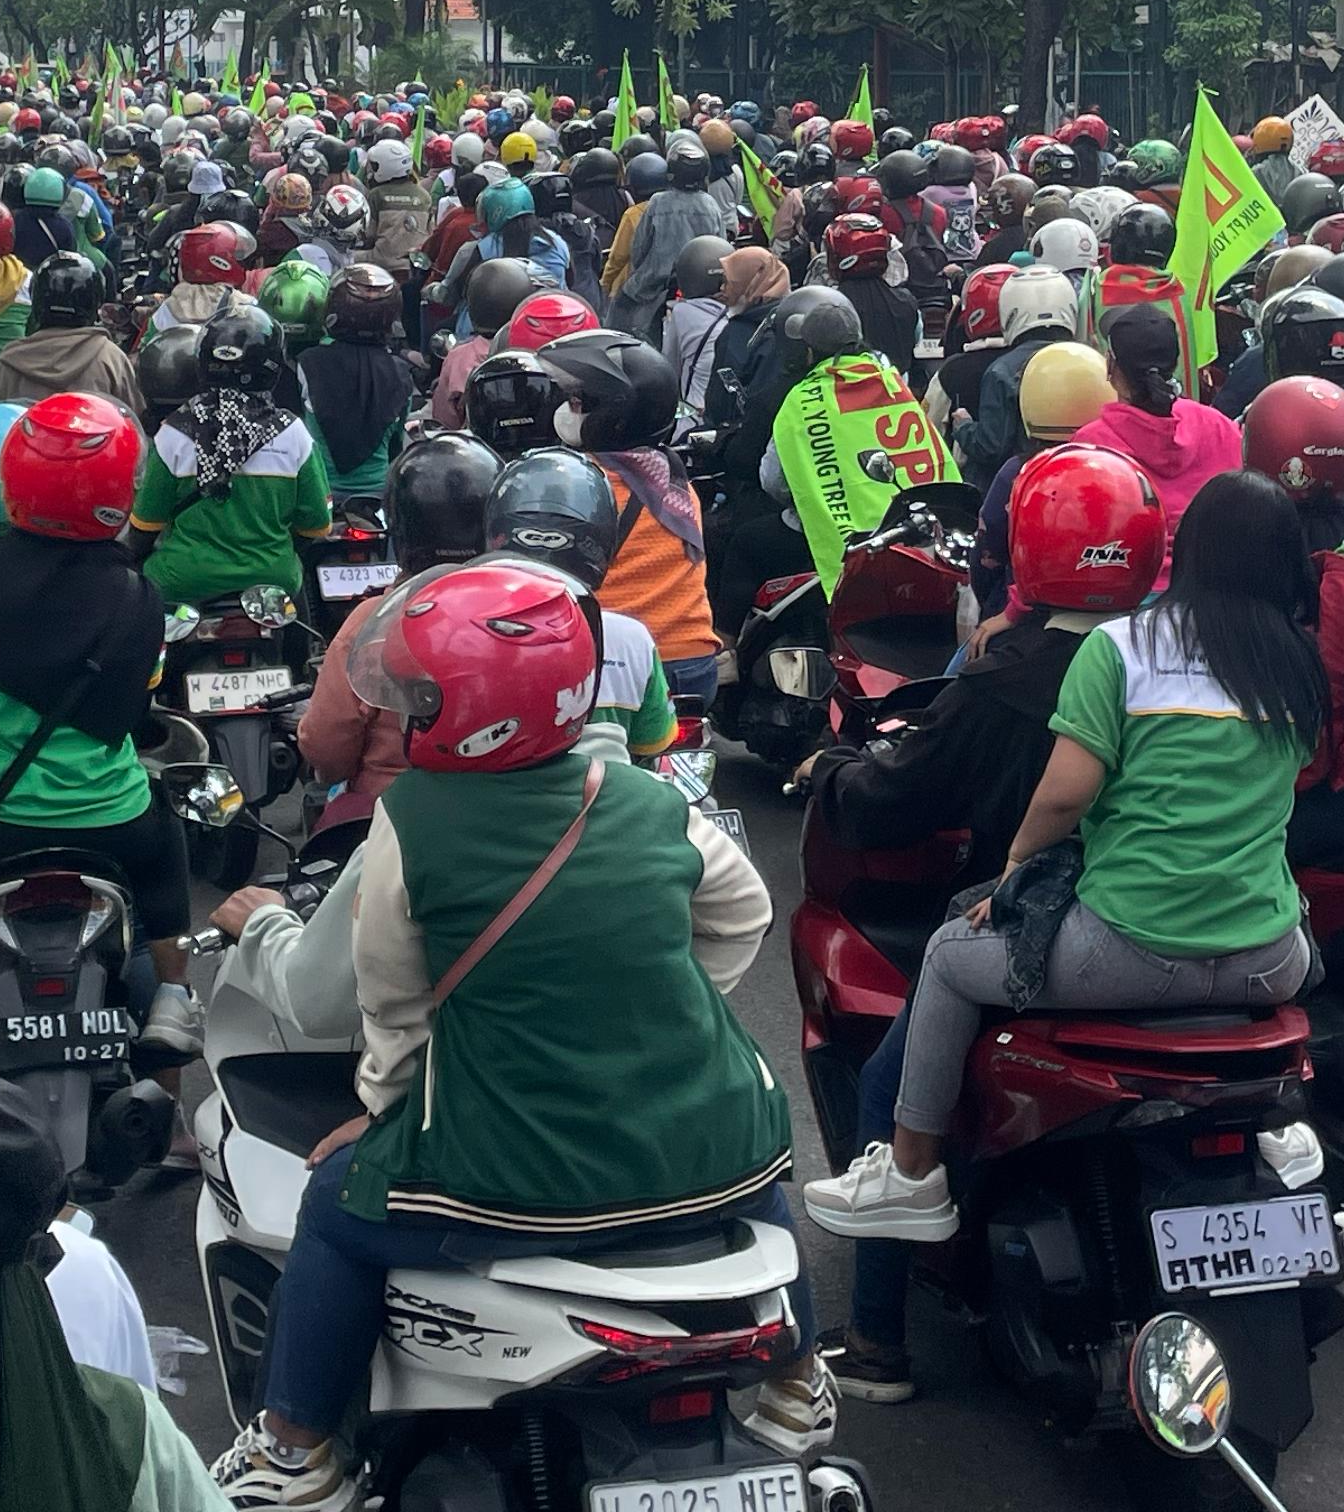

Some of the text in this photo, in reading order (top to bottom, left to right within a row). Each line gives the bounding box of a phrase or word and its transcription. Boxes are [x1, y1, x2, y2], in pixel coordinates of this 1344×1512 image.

[800, 385, 824, 410] PT.
[804, 409, 840, 478] YOUNG
[821, 477, 852, 521] TREE
[1082, 548, 1126, 561] INK
[322, 570, 331, 582] S
[339, 568, 370, 582] 4323
[211, 674, 249, 691] 4487
[256, 672, 285, 687] NHC
[7, 1013, 67, 1042] 5581
[81, 1010, 127, 1035] NDL
[1160, 1203, 1324, 1249] S 4354 VF
[1167, 1248, 1255, 1285] ATHA
[387, 1315, 484, 1358] PCX
[502, 1346, 532, 1358] NEW
